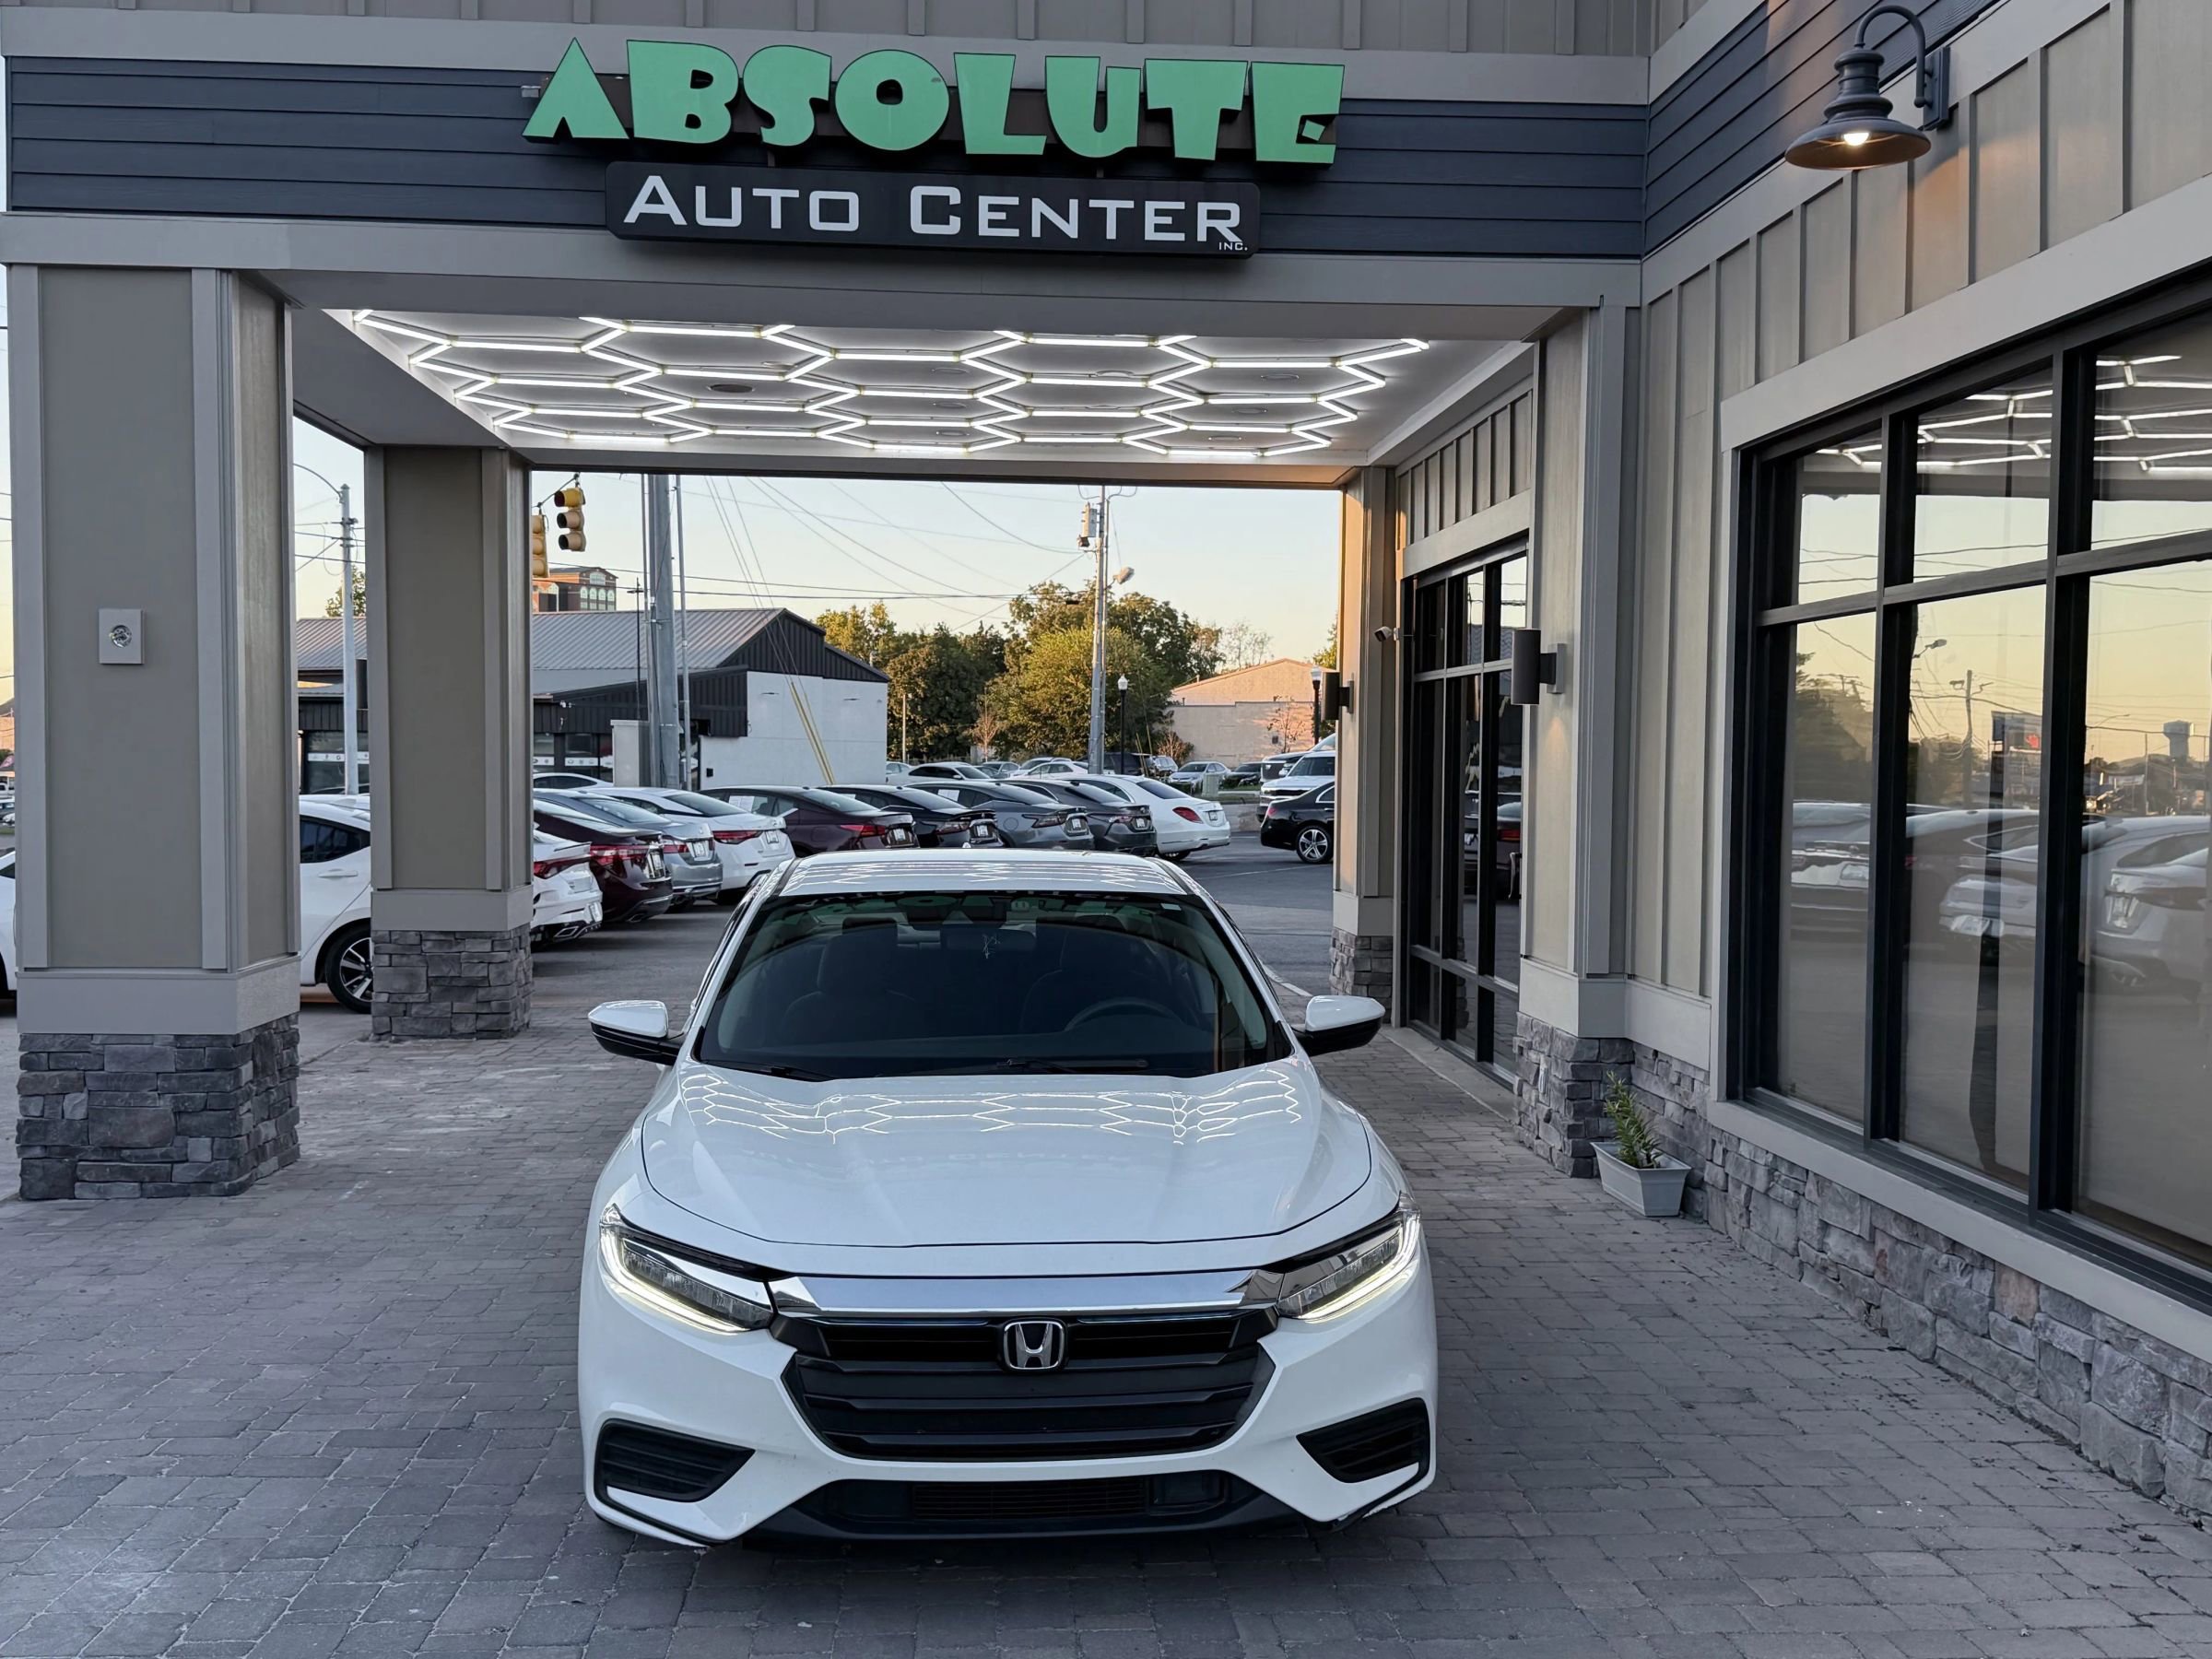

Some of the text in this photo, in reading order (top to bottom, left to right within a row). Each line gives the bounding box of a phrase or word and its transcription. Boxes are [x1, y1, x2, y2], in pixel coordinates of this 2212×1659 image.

[522, 37, 1346, 164] ABSOLUTE
[623, 175, 1242, 242] AUTO CENTER
[1218, 241, 1249, 251] INC.
